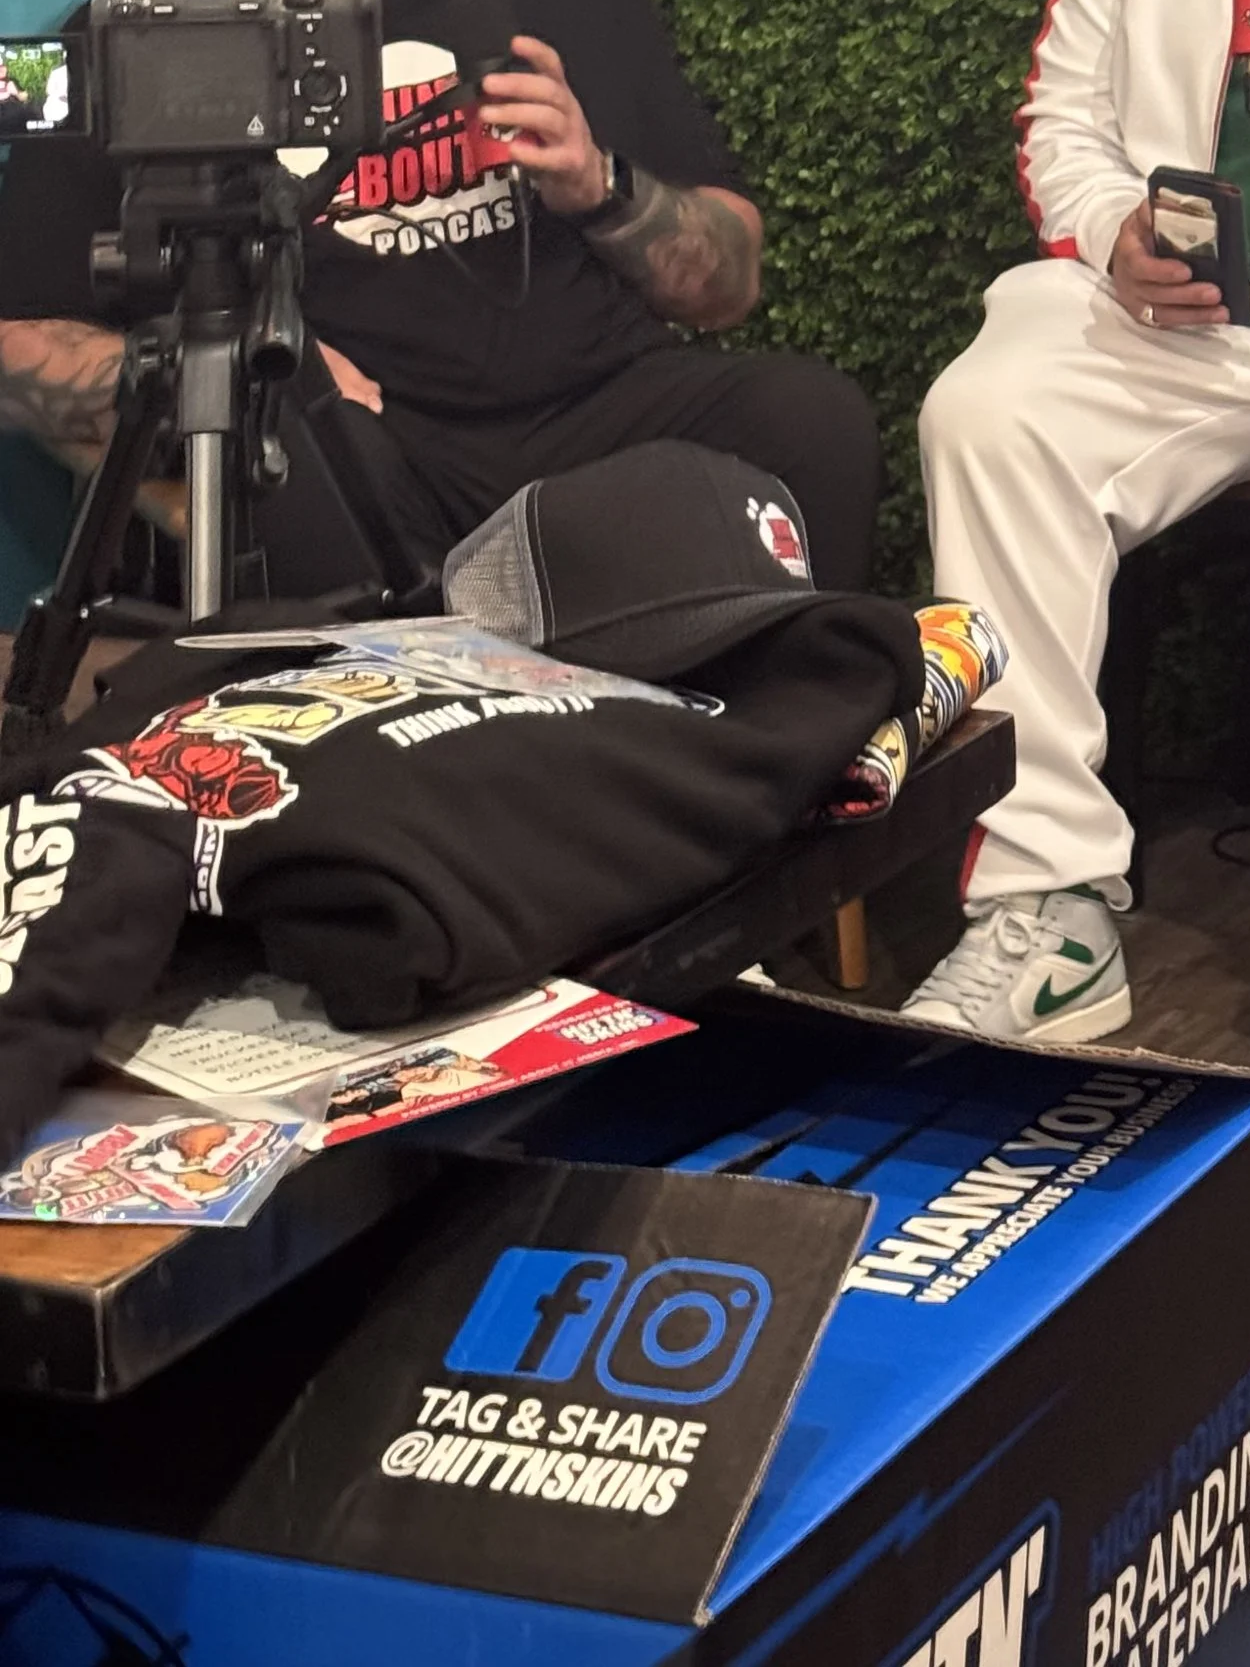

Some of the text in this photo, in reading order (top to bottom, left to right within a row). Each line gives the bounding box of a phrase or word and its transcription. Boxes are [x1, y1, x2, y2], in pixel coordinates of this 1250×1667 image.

[373, 196, 518, 256] PODCAS
[377, 701, 482, 747] THINK
[842, 1071, 1163, 1296] THANK YOU!
[914, 1274, 969, 1304] WE
[951, 1184, 1074, 1278] APPRECIATE
[1054, 1145, 1124, 1184] YOUR
[416, 1386, 707, 1463] TAG & SHARE
[381, 1430, 688, 1517] @HITTNSKINS
